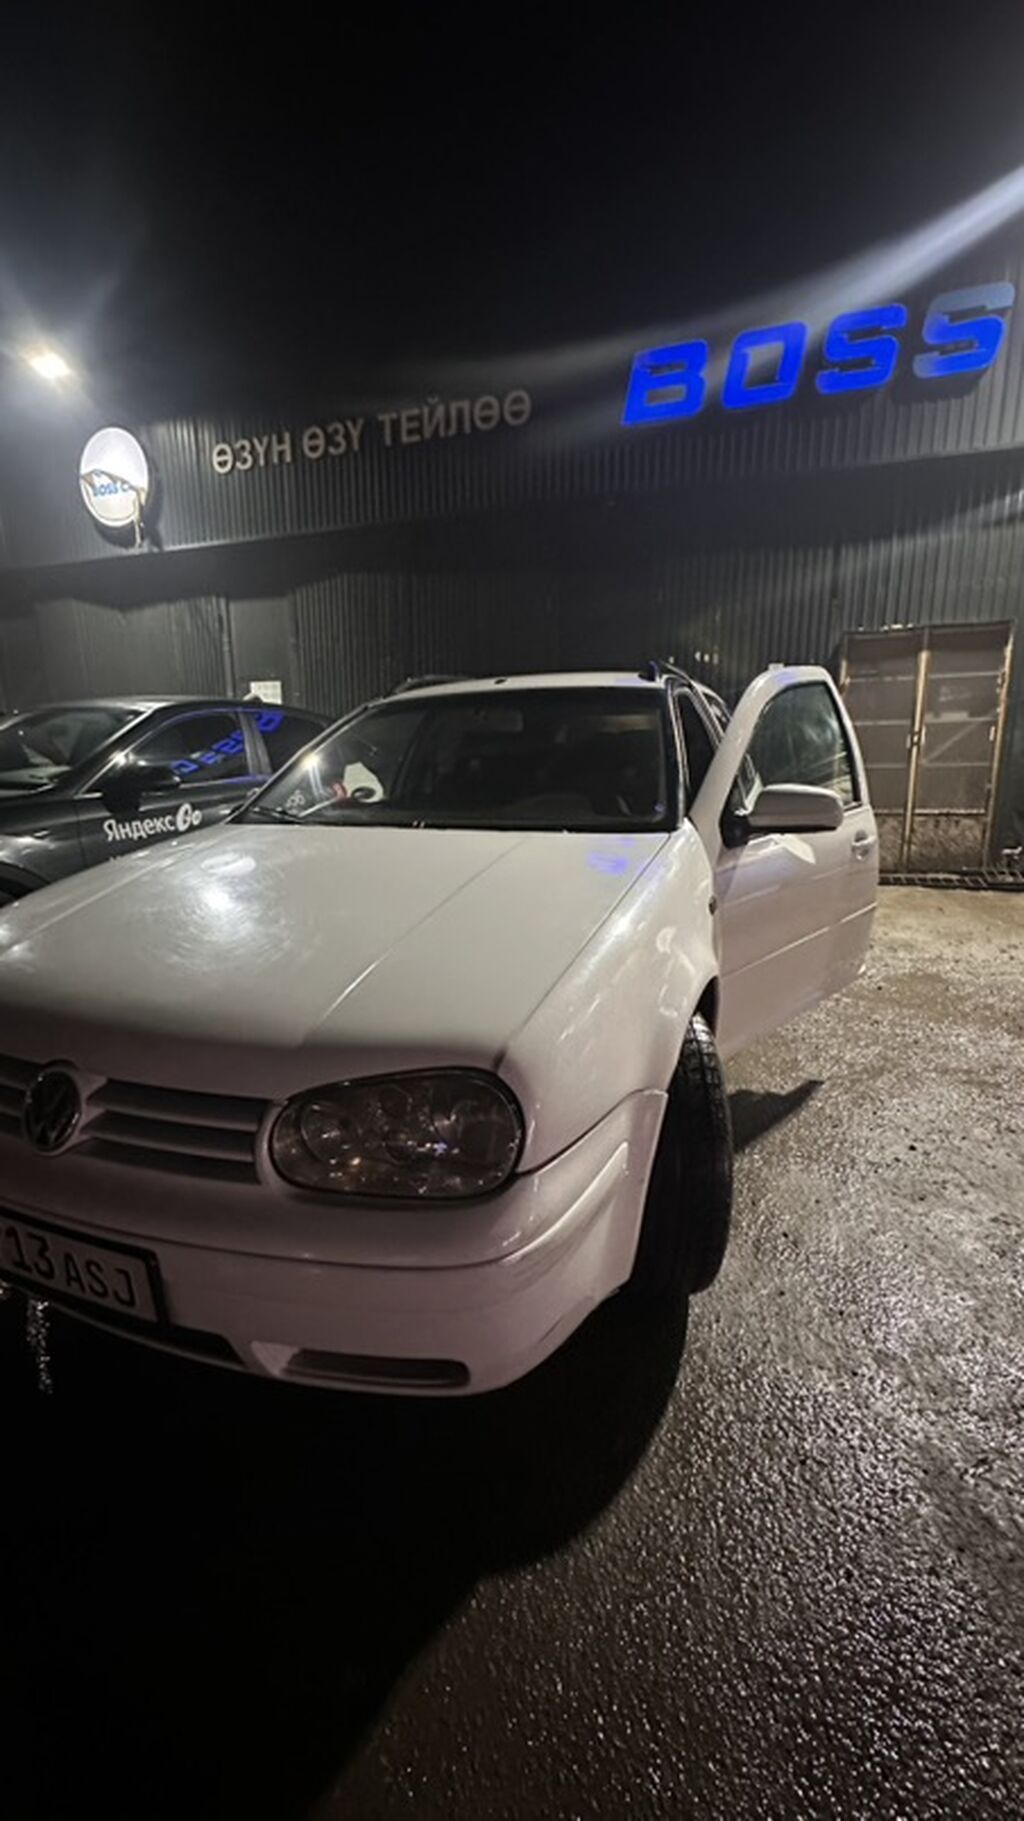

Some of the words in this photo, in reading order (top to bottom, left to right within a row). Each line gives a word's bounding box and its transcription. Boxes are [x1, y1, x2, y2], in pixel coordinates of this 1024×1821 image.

[620, 282, 1015, 426] BOSS
[211, 431, 292, 474] ӨЗҮН
[303, 417, 364, 459] ӨЗҮ
[378, 389, 531, 446] ТЕЙЛӨӨ
[103, 816, 175, 842] Яндекс
[176, 803, 202, 832] Go
[0, 1225, 55, 1281] 13
